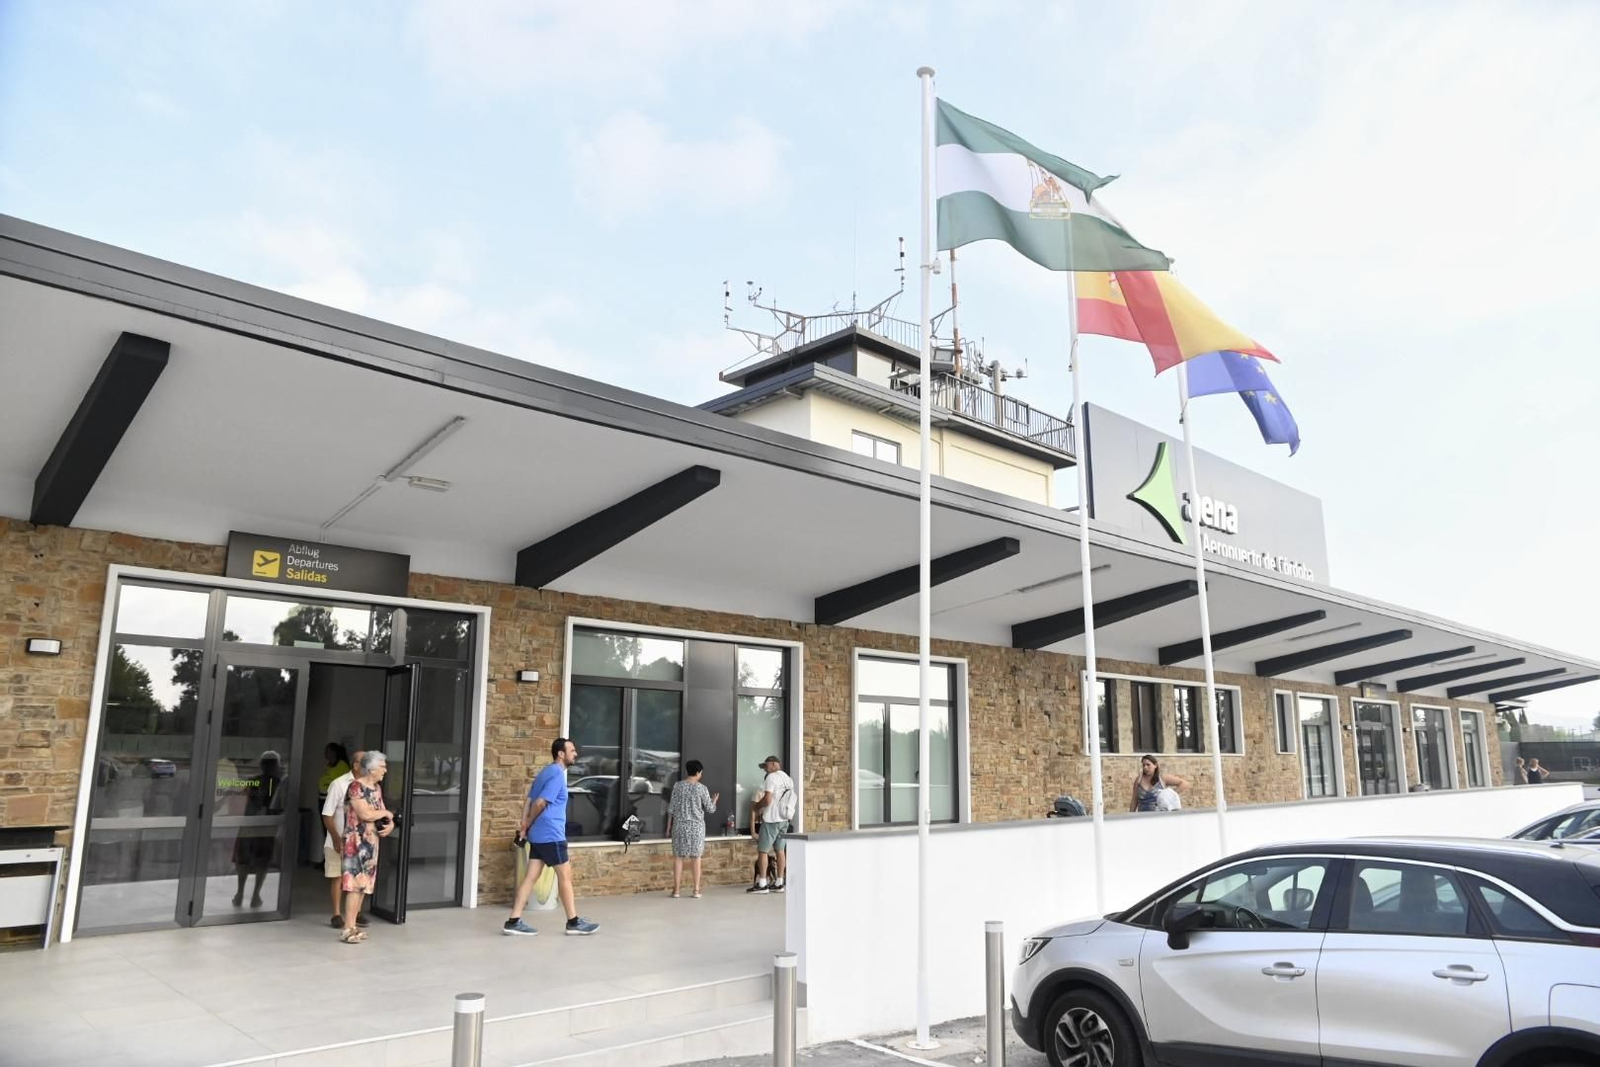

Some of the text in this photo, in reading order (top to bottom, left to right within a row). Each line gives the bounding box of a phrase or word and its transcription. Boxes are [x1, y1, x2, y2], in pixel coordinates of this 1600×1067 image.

[288, 544, 320, 559] Abflug
[286, 555, 339, 571] Departures
[1263, 553, 1276, 570] de
[286, 568, 327, 583] Salidas
[218, 778, 260, 787] Welcome
